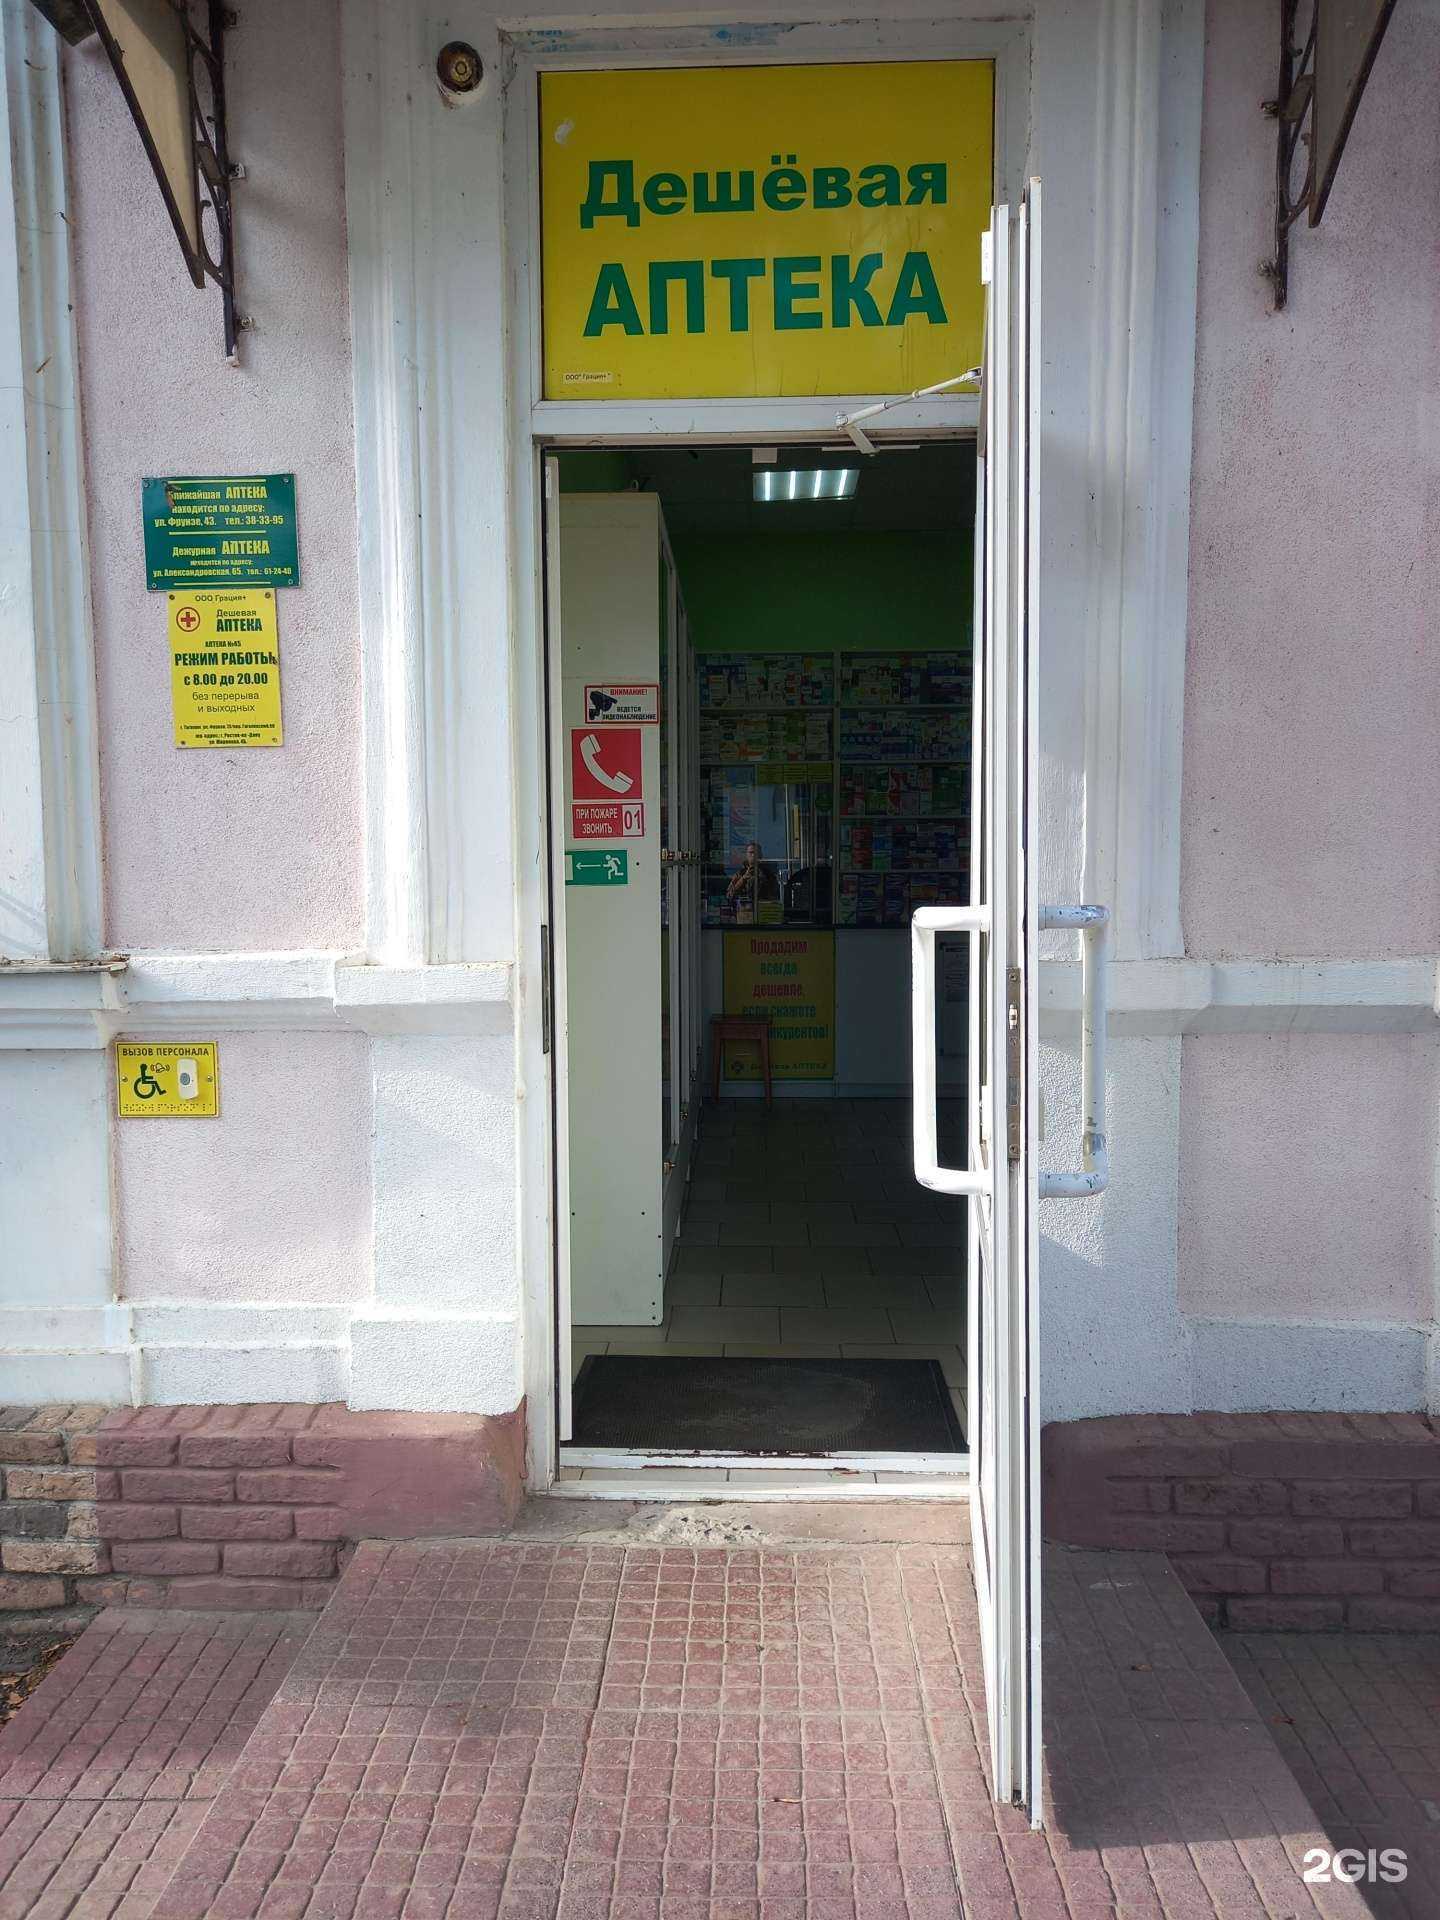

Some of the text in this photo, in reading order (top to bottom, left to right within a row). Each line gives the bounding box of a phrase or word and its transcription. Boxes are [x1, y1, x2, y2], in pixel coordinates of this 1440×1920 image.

[580, 154, 948, 229] Дешёвая
[582, 251, 949, 337] АПТЕКА
[225, 486, 268, 499] АПТЕКА
[171, 504, 265, 514] находится по адресу:
[154, 518, 167, 528] ул.
[245, 515, 284, 526] 38-33-95
[172, 540, 271, 558] Дежурная АПТЕКА
[216, 609, 257, 618] Дешевая
[216, 618, 263, 632] АПТЕКА
[175, 653, 219, 666] РЕЖИМ
[184, 672, 268, 687] с 8.00 до 20.00
[192, 692, 260, 702] без перерыва
[609, 688, 647, 696] ВНИМАНИЕ!
[206, 705, 256, 714] выходных
[575, 807, 618, 819] ПРИ ПОЖАРЕ
[624, 810, 641, 830] 01
[582, 822, 613, 834] ЗВОНИТЬ
[751, 939, 807, 956] Продадим
[761, 961, 798, 976] всегда
[122, 1047, 210, 1057] ВЫЗОВ ПЕРСОНАЛА
